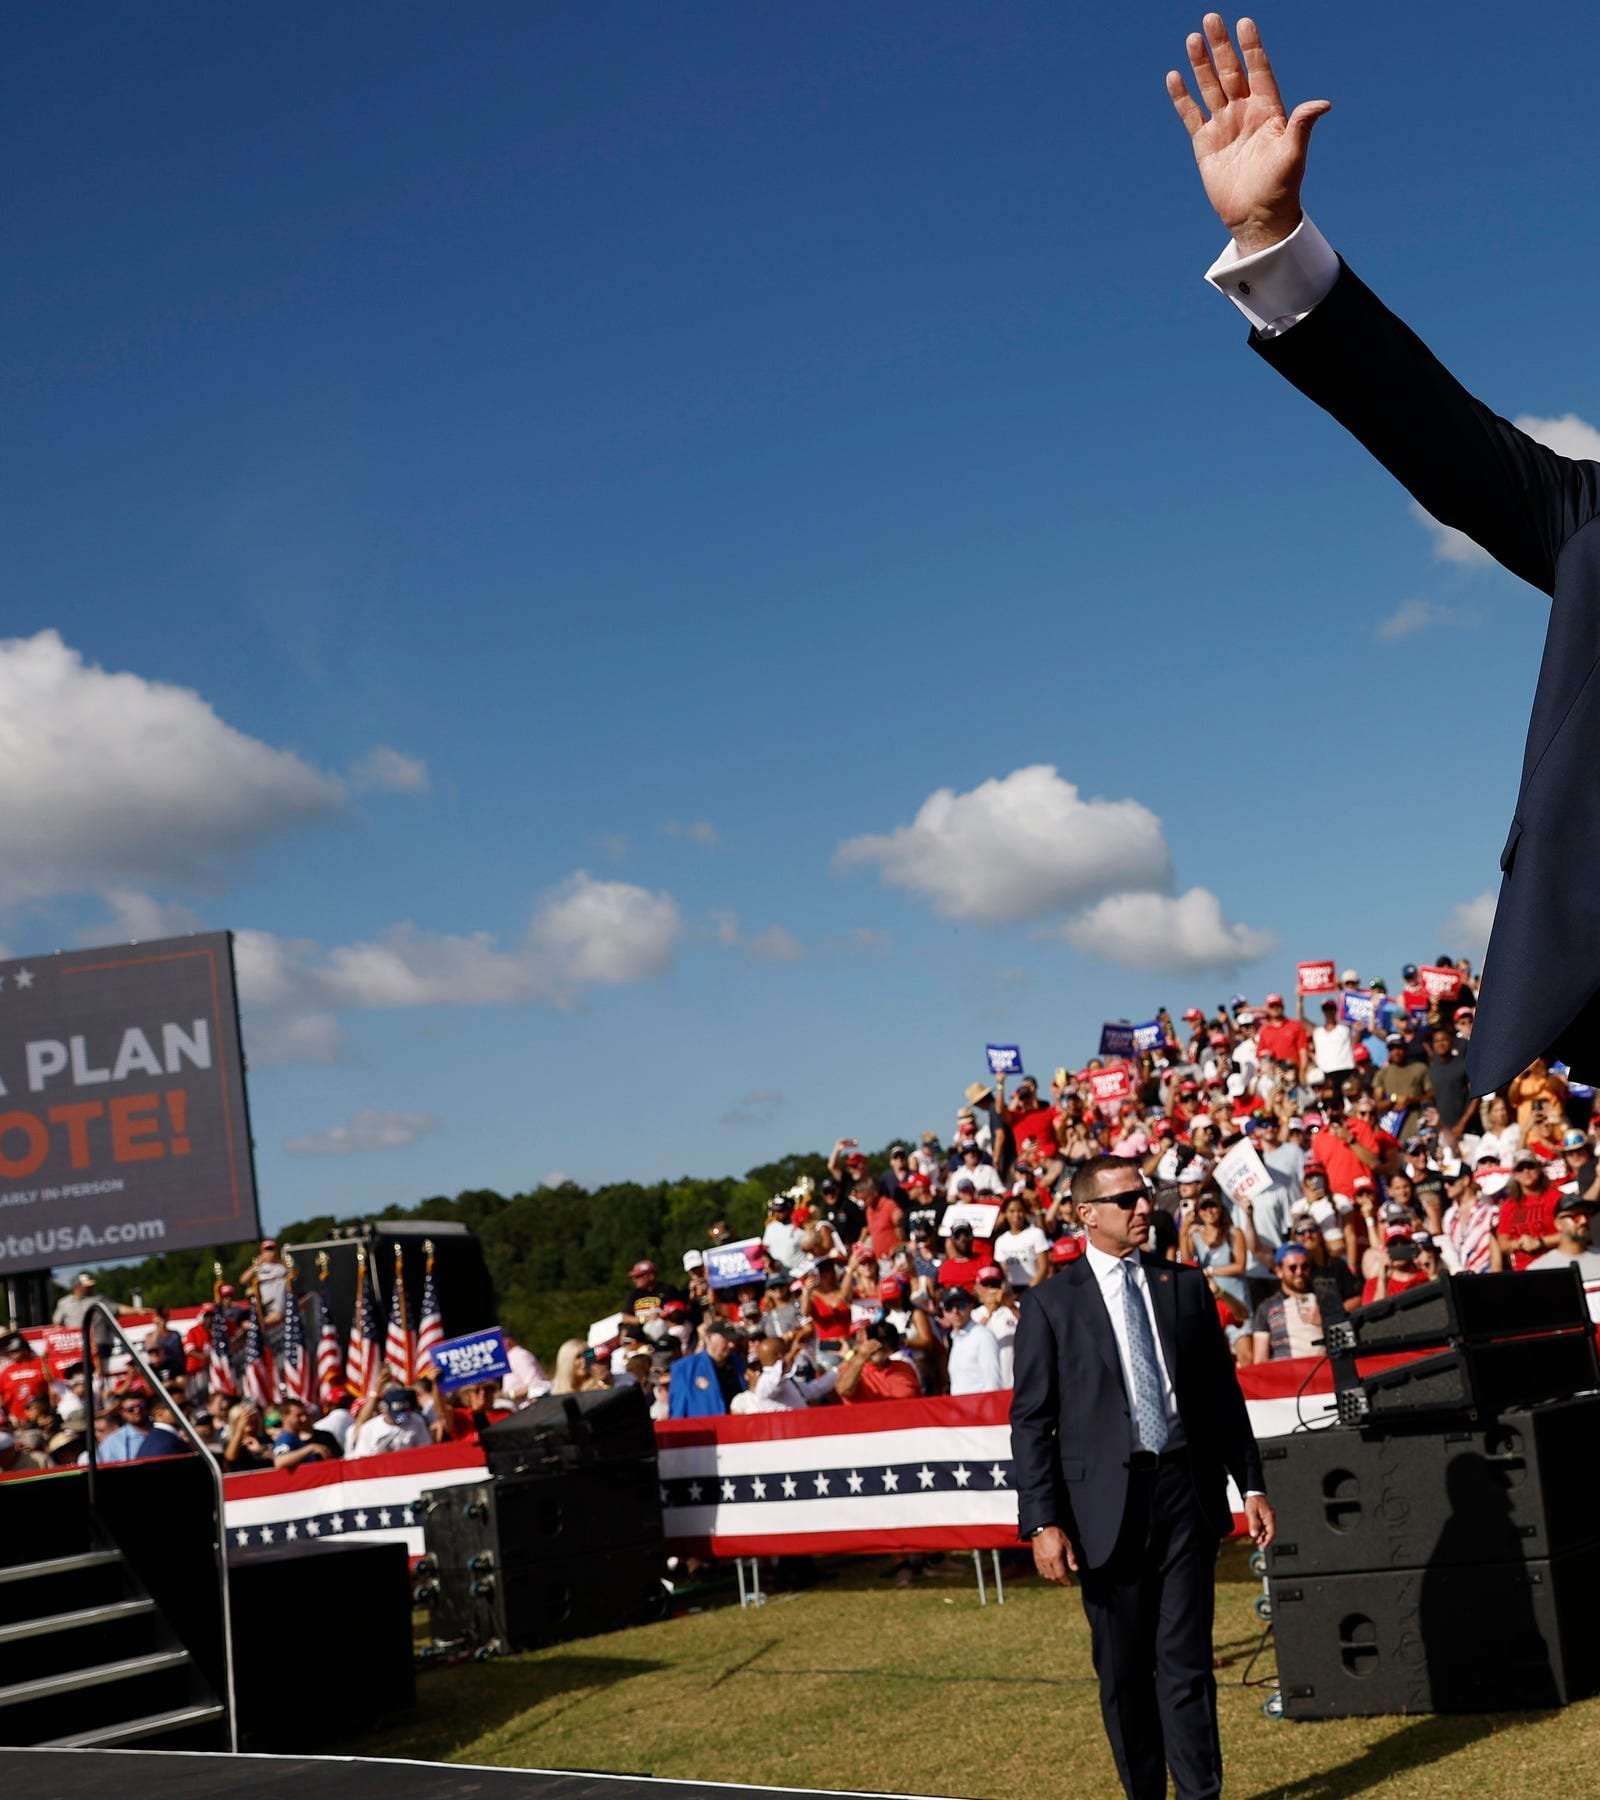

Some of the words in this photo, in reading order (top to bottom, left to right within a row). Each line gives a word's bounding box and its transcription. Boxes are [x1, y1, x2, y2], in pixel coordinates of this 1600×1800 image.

[25, 1018, 211, 1092] PLAN
[0, 1089, 191, 1179] OTE!
[436, 1339, 498, 1366] TRUMP
